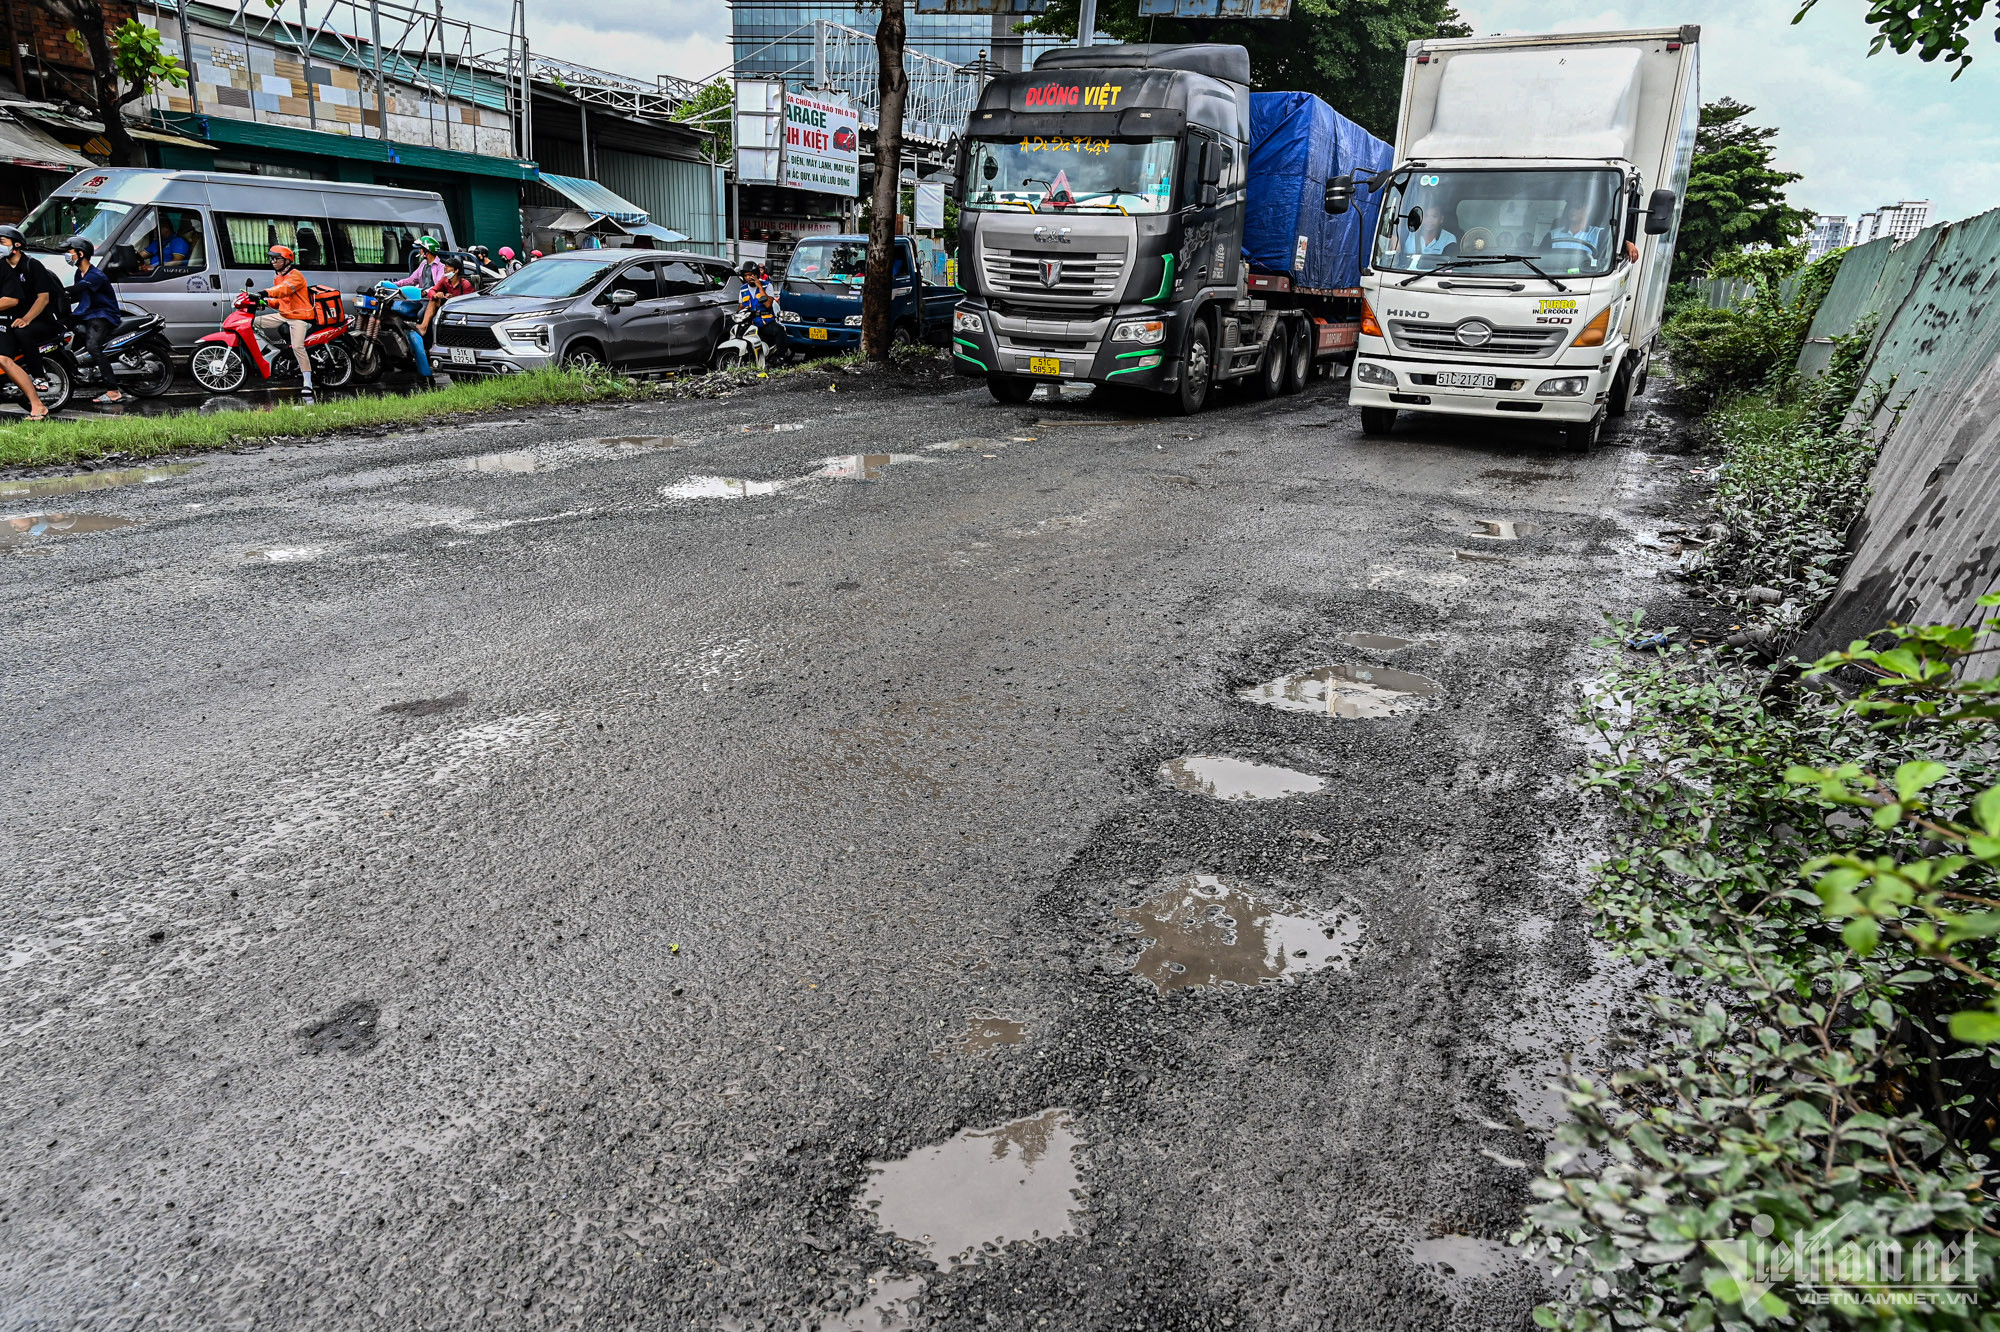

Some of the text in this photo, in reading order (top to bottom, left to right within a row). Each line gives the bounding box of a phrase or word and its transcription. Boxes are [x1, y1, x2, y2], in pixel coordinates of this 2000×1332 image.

[1025, 82, 1122, 110] ĐƯỜNG VIỆT
[803, 129, 829, 153] KIỆT
[1539, 300, 1576, 314] TURBO
[1386, 309, 1430, 319] HINO
[1536, 317, 1573, 325] 500
[1038, 358, 1051, 366] 51C
